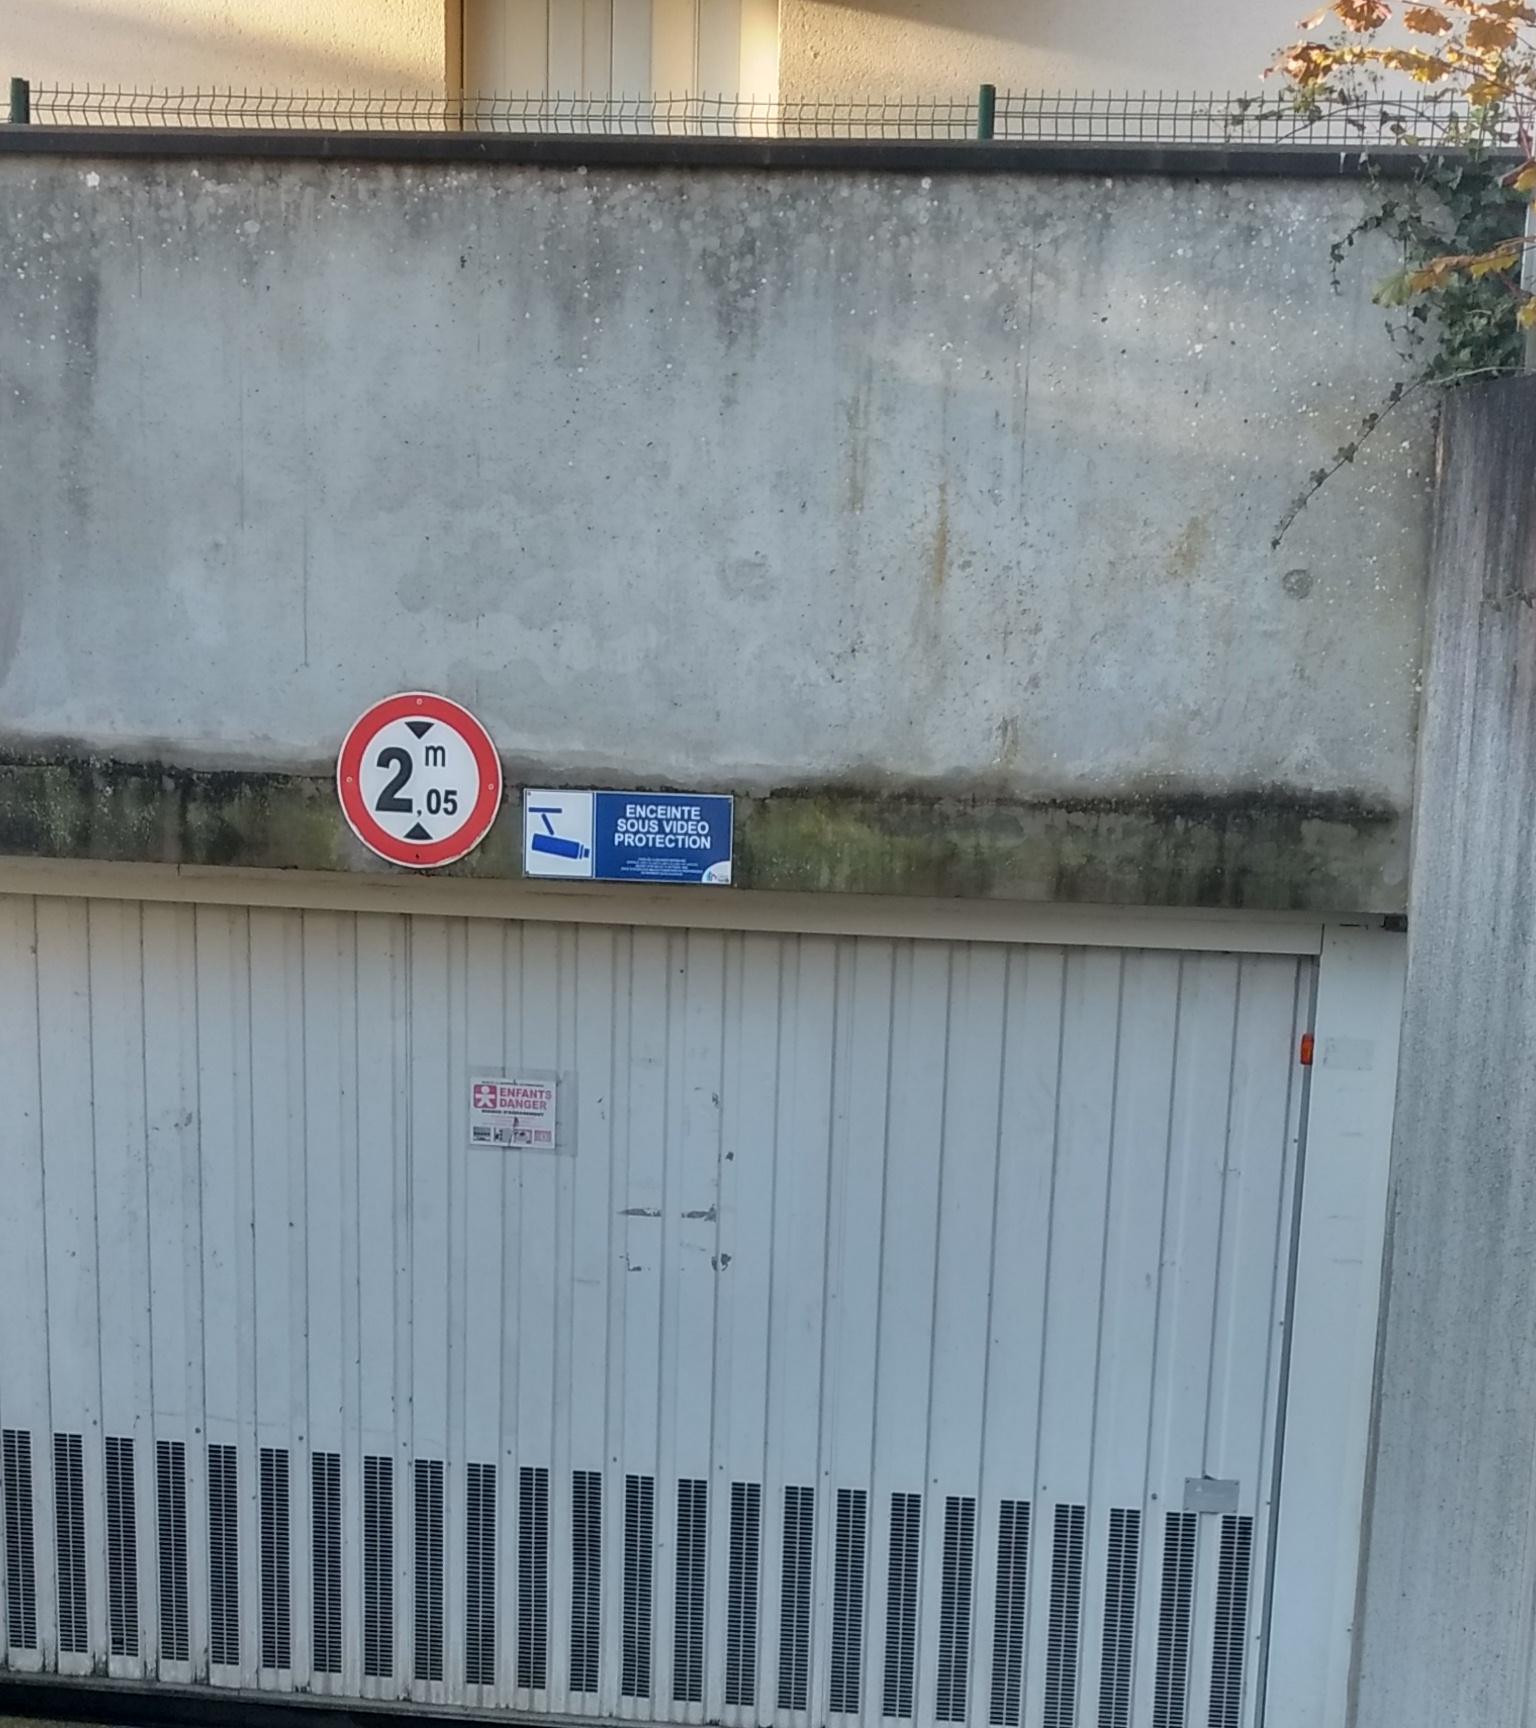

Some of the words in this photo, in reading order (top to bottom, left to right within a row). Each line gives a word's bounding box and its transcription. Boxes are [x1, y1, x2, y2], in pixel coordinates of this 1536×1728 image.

[375, 747, 413, 813] 2
[425, 745, 446, 767] m
[626, 804, 701, 820] ENCEINTE
[617, 818, 659, 833] SOUS
[662, 820, 709, 835] VIDEO
[614, 833, 711, 849] PROTECTION
[499, 1087, 552, 1100] ENFANTS
[499, 1098, 547, 1110] DANGER
